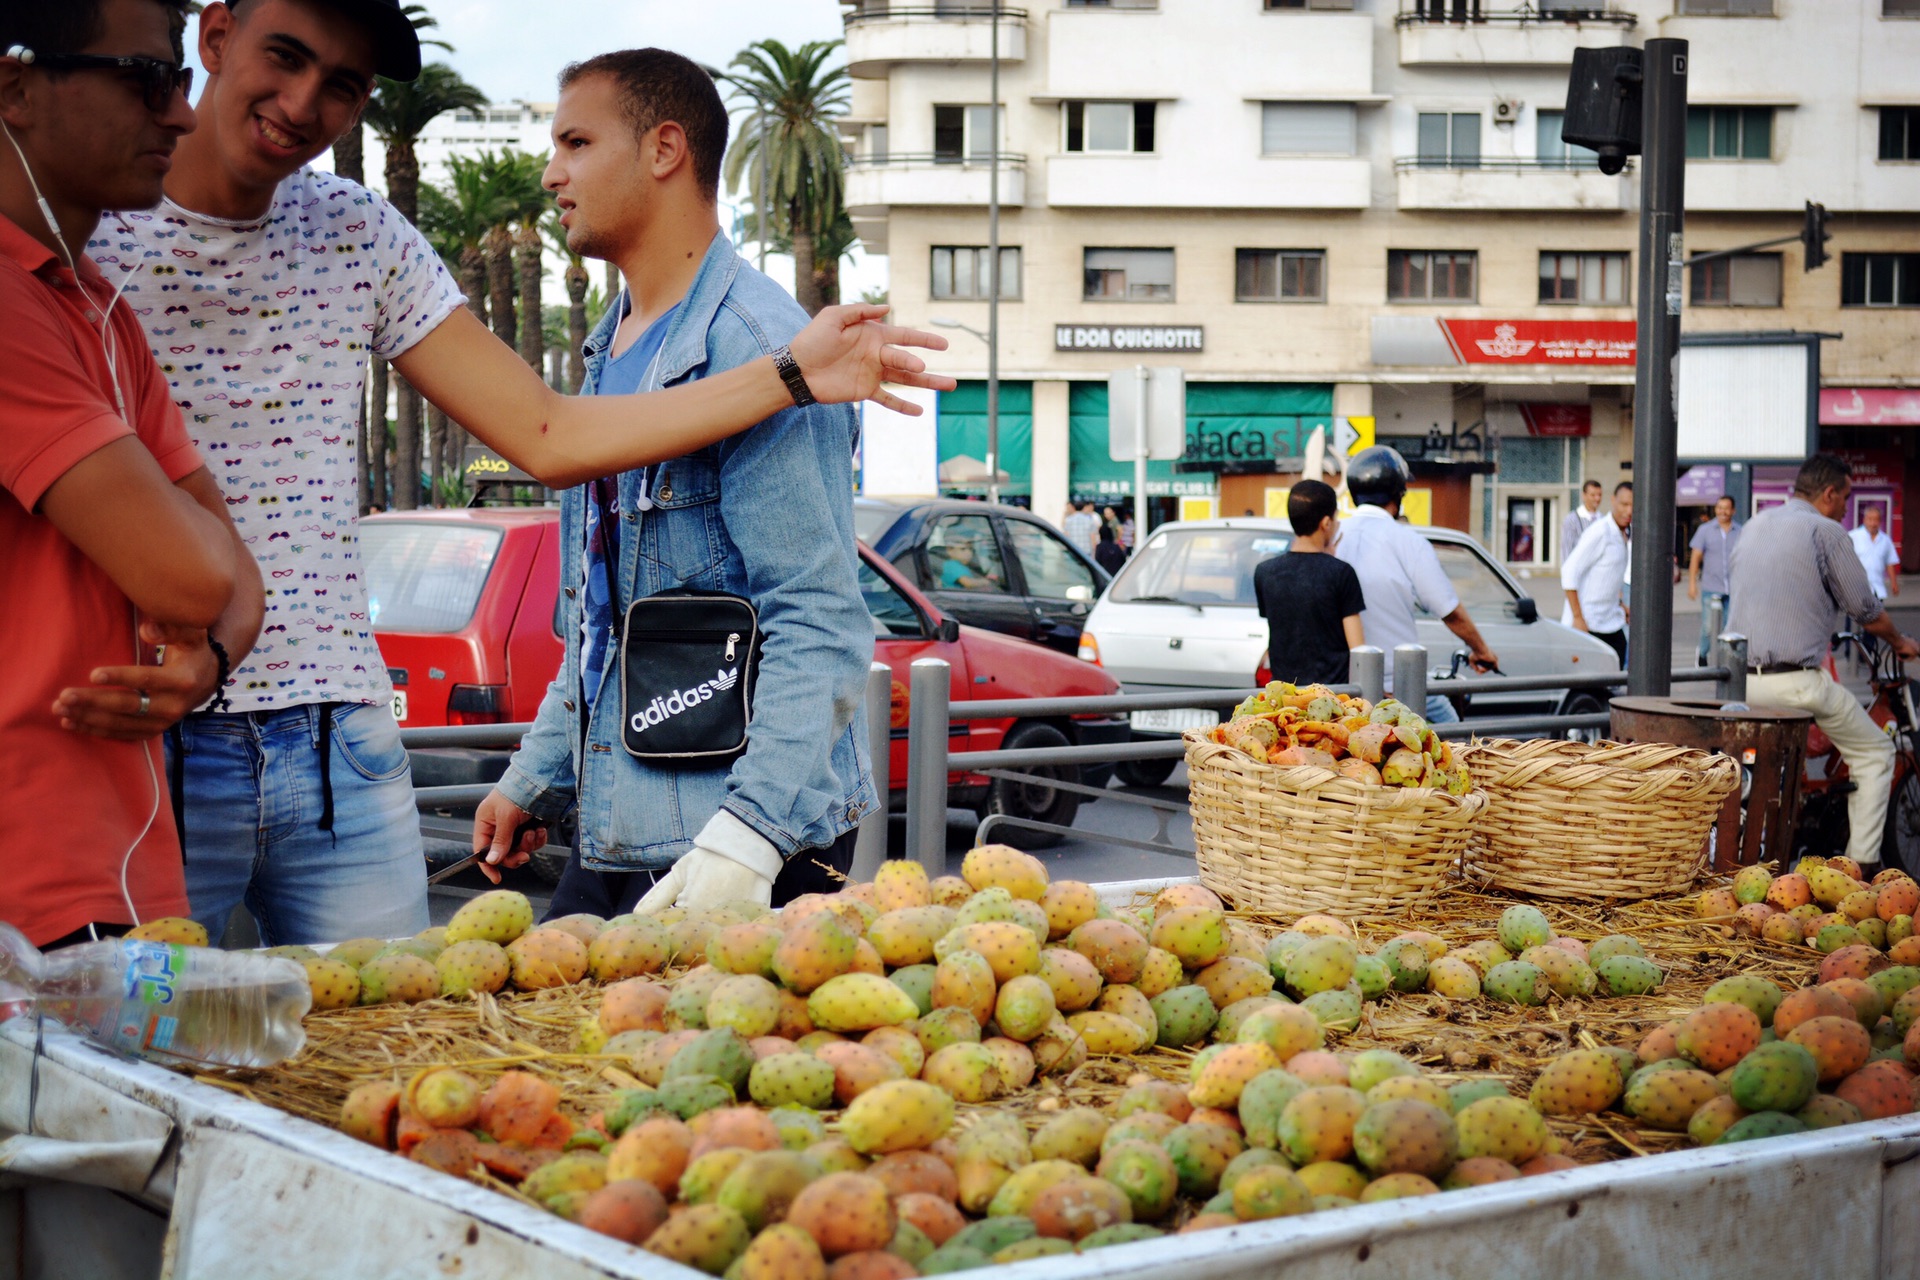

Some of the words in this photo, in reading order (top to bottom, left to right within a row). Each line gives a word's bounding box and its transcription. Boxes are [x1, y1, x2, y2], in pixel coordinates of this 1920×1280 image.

[1676, 57, 1686, 72] D
[1056, 327, 1073, 347] LE
[1074, 327, 1111, 348] DON
[1112, 328, 1203, 349] QUICHOTTE
[465, 454, 510, 476] صغير
[1099, 480, 1131, 494] BAR
[631, 683, 713, 732] adidas
